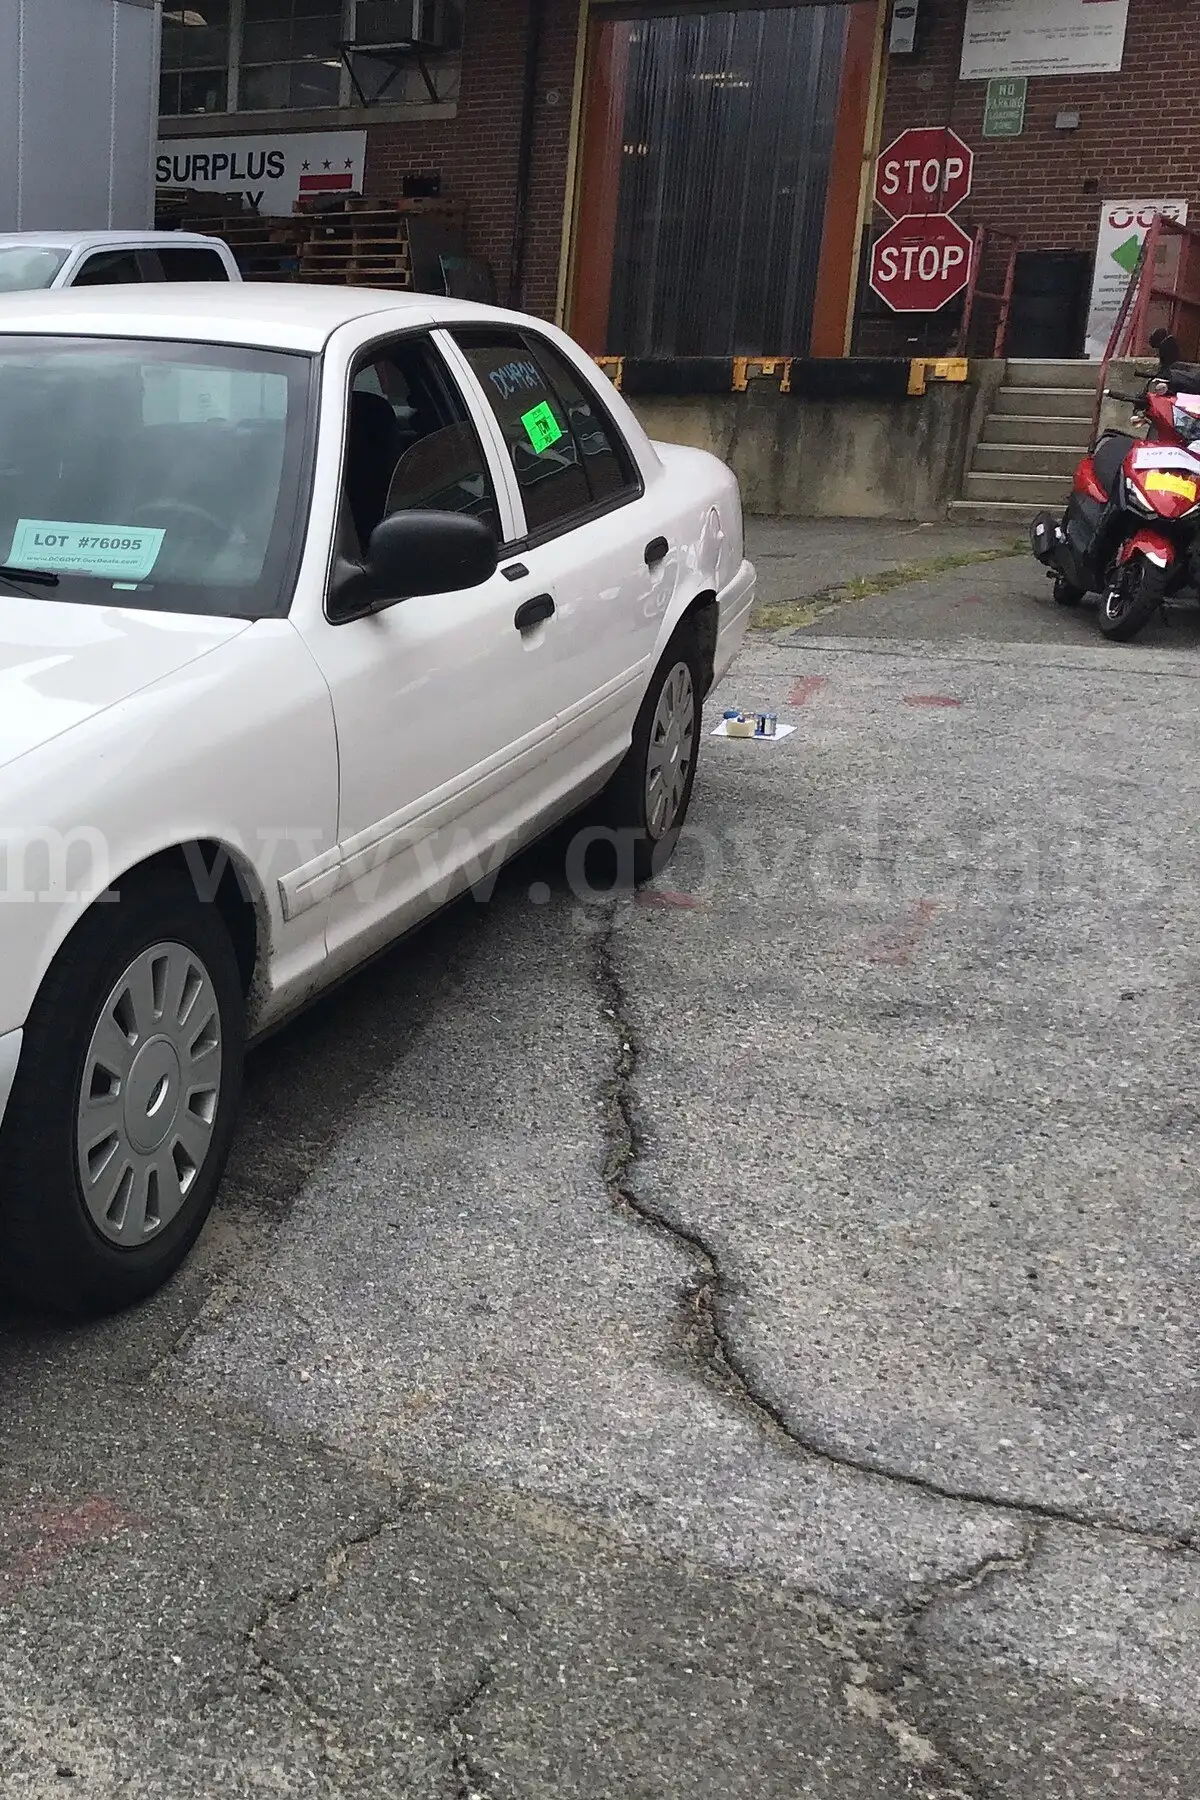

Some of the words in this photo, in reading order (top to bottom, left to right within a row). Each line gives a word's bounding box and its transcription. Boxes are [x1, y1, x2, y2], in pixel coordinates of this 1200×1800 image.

[999, 84, 1015, 95] NO
[155, 150, 285, 183] SURPLUS
[881, 157, 964, 195] STOP
[877, 245, 964, 281] STOP
[34, 533, 69, 547] LOT
[77, 536, 143, 550] #76095
